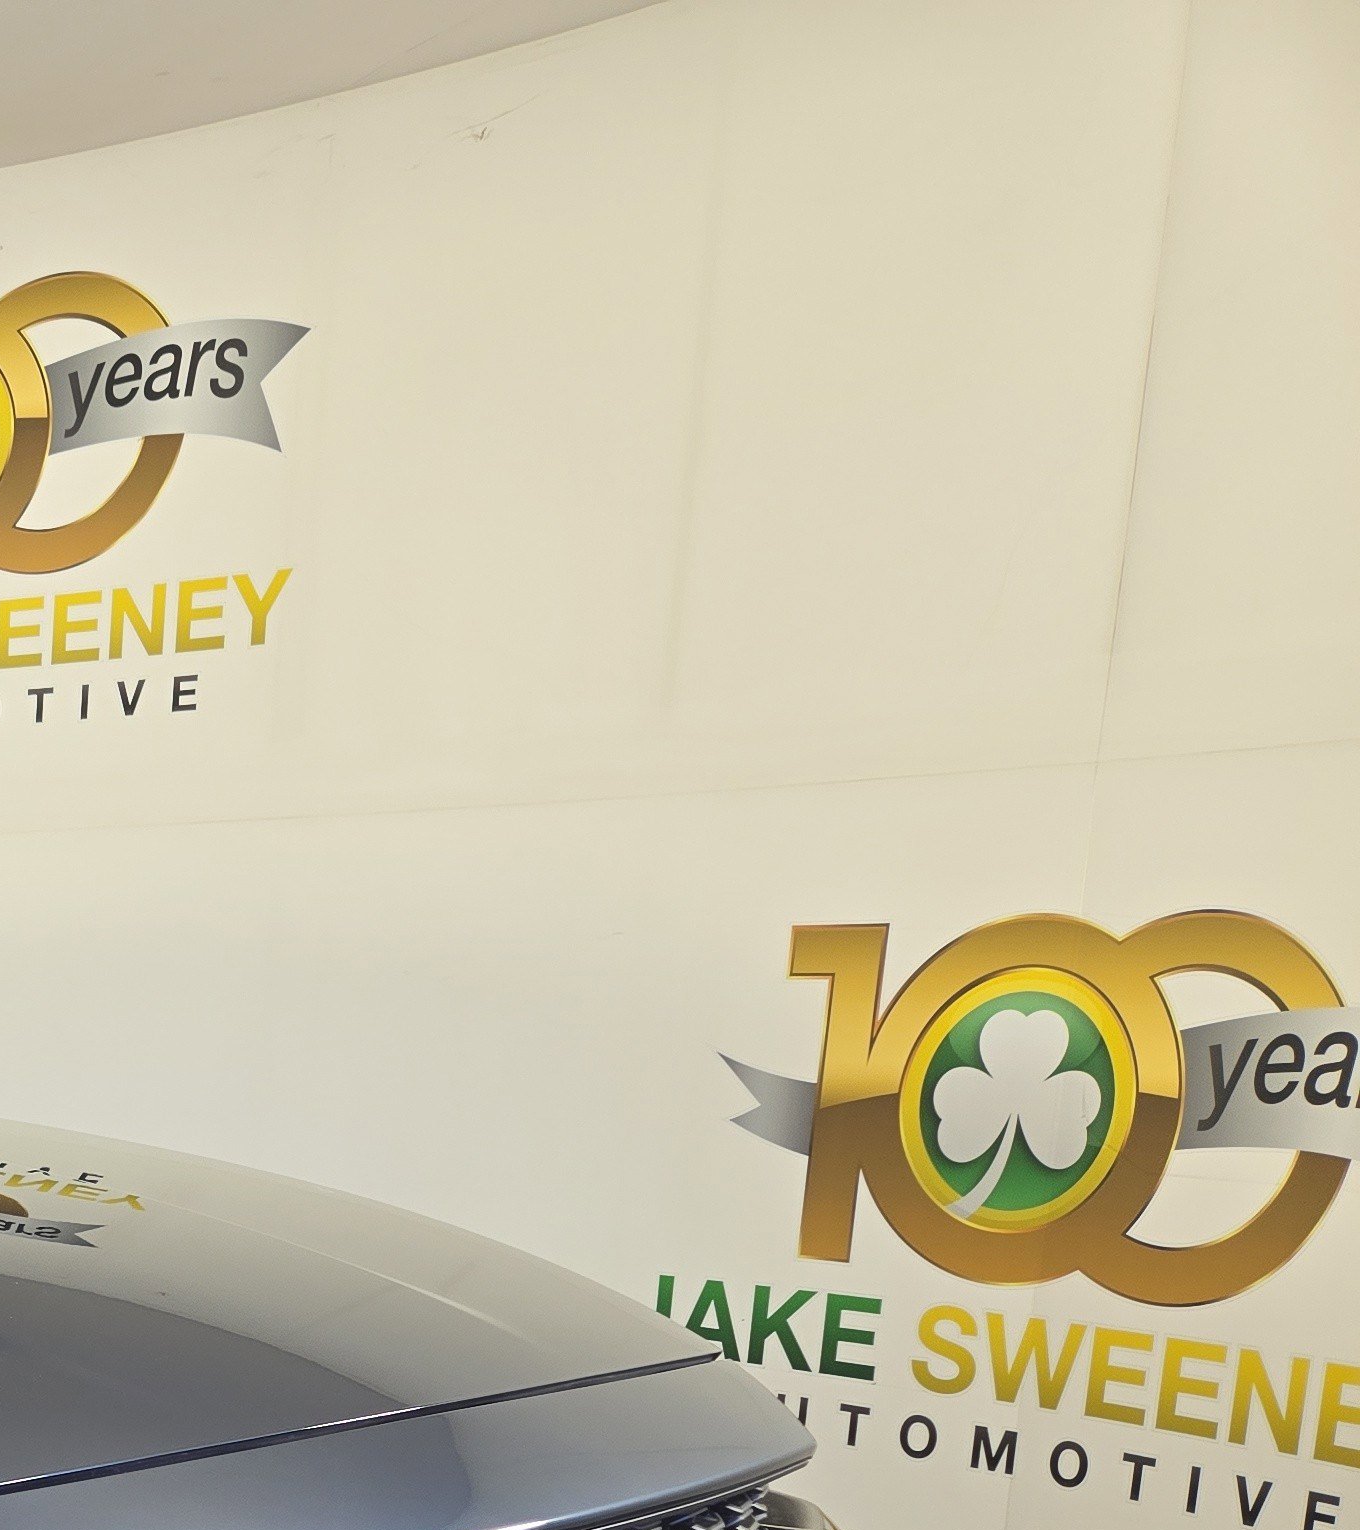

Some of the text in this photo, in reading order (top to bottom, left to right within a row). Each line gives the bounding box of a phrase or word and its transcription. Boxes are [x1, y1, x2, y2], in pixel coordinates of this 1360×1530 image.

[63, 335, 248, 439] years
[1197, 1030, 1360, 1132] yea
[910, 1303, 1360, 1470] SWEENE
